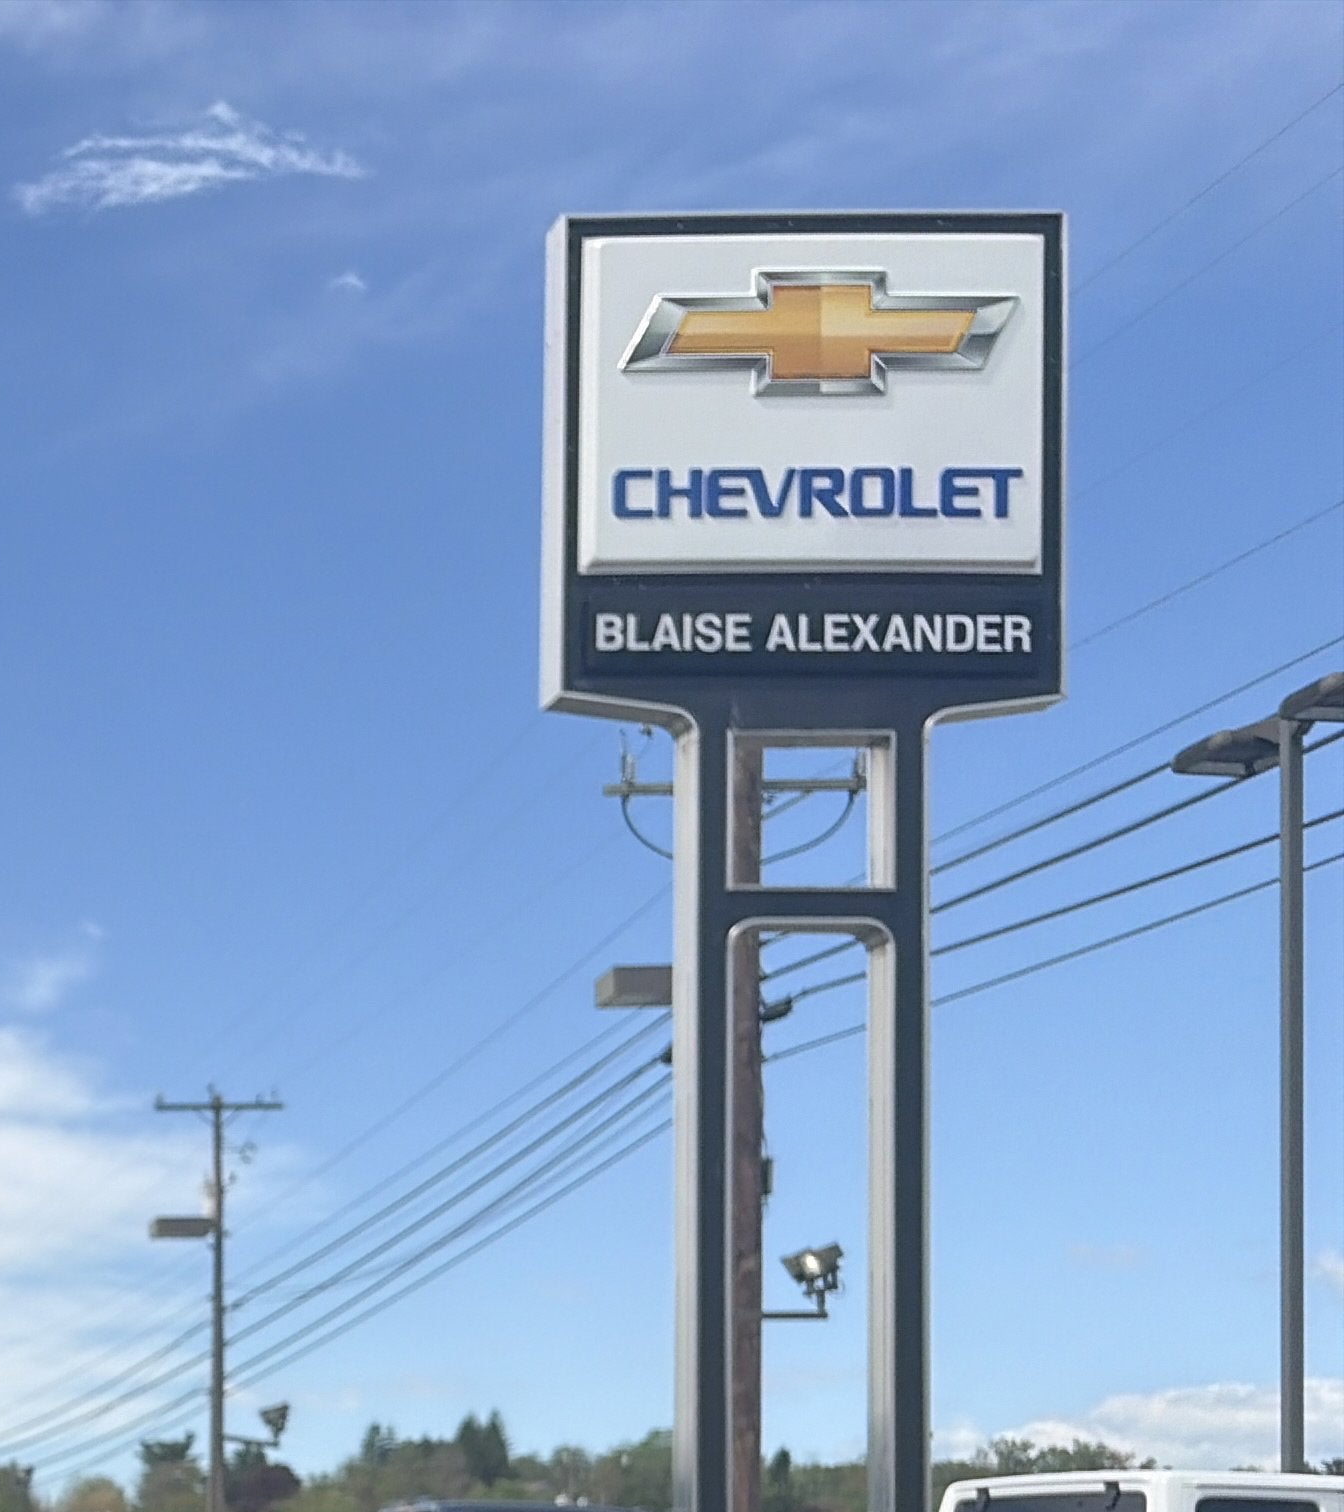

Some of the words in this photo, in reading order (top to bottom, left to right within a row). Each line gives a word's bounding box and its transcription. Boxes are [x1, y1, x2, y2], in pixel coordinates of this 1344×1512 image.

[614, 468, 1023, 518] CHEVROLET
[596, 613, 751, 653] BLAISE
[766, 613, 1032, 653] ALEXANDER
